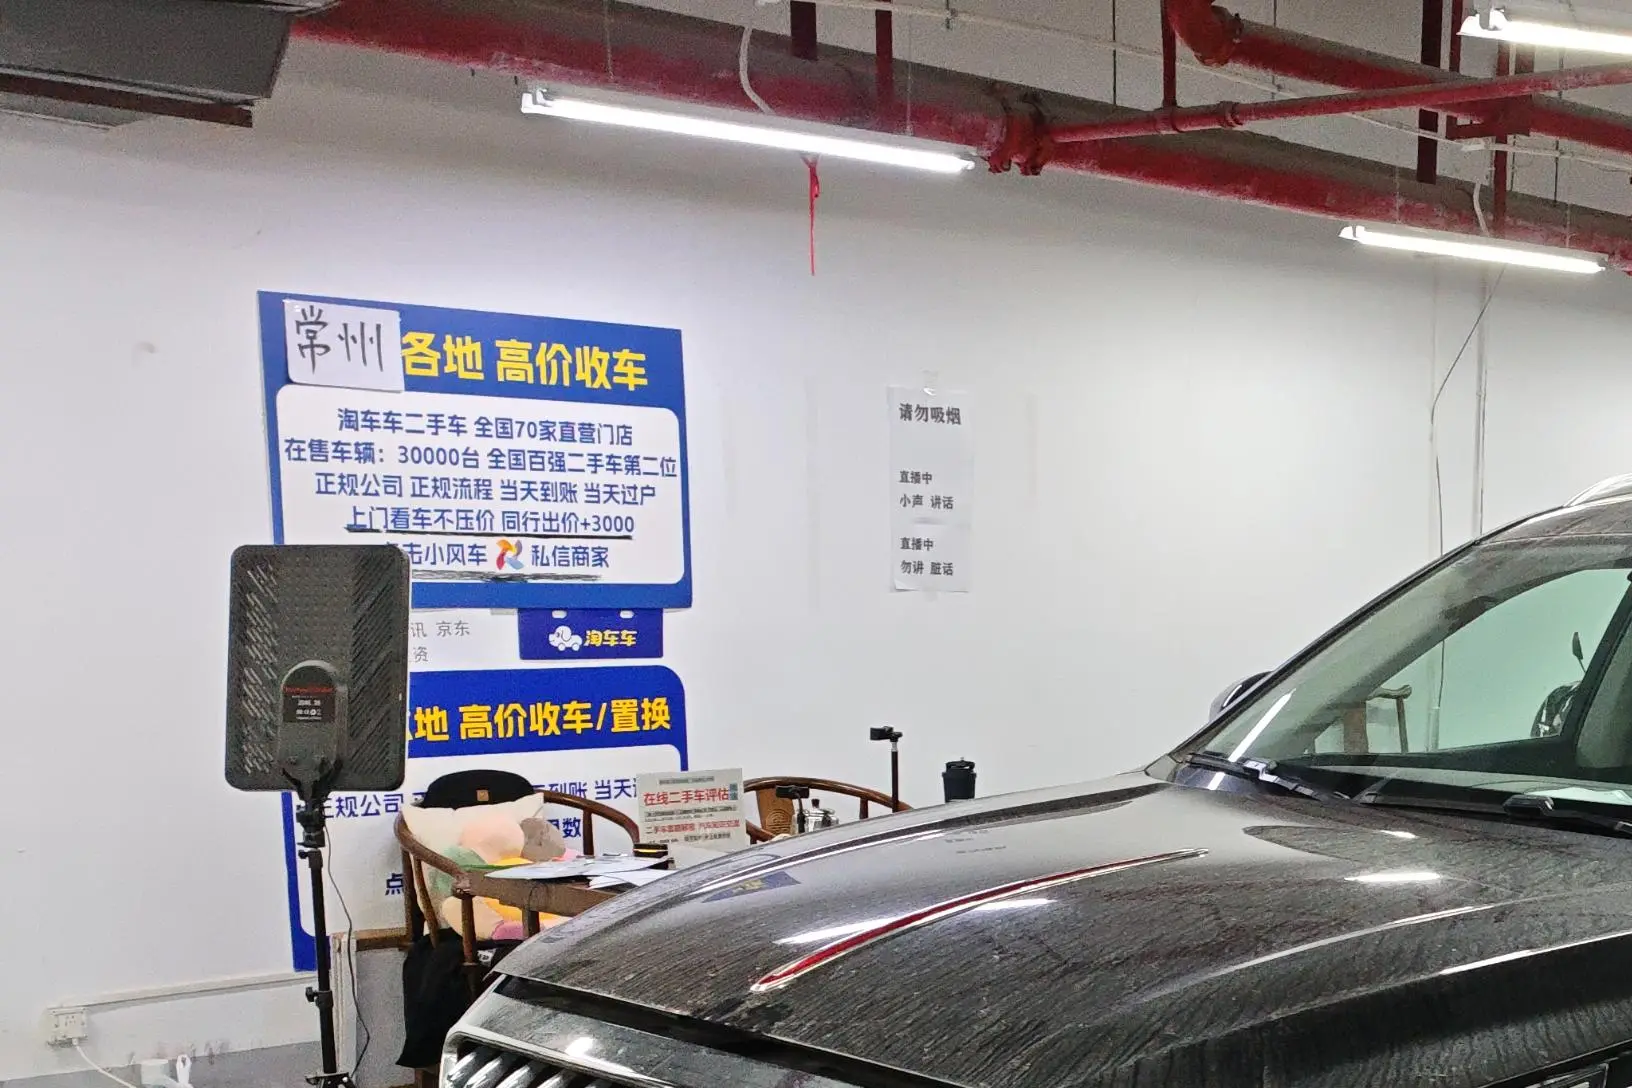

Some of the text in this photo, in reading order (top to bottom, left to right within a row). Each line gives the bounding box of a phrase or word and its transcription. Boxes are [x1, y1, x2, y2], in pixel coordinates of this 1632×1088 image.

[293, 304, 385, 374] 常州
[401, 331, 649, 391] 各地 高价收车
[899, 403, 962, 425] 请勿吸烟
[338, 407, 633, 446] 淘车车二手车 全国70家直营门店
[487, 448, 678, 478] 全国百强二手车第二位
[315, 472, 656, 505] 正规公司 正规流程 当天到账 当天过户
[899, 470, 933, 485] 直播中
[899, 494, 954, 510] 小声 讲话
[348, 505, 635, 533] 上门看车不压价 同行出价+3000
[385, 541, 610, 568] 击小风车 私信商家
[900, 537, 934, 551] 直播中
[900, 560, 924, 575] 勿讲
[436, 619, 471, 637] 京东
[583, 629, 637, 647] 淘车车
[408, 696, 672, 741] 地 高价收车/置换
[643, 787, 730, 806] 在线二手车评估
